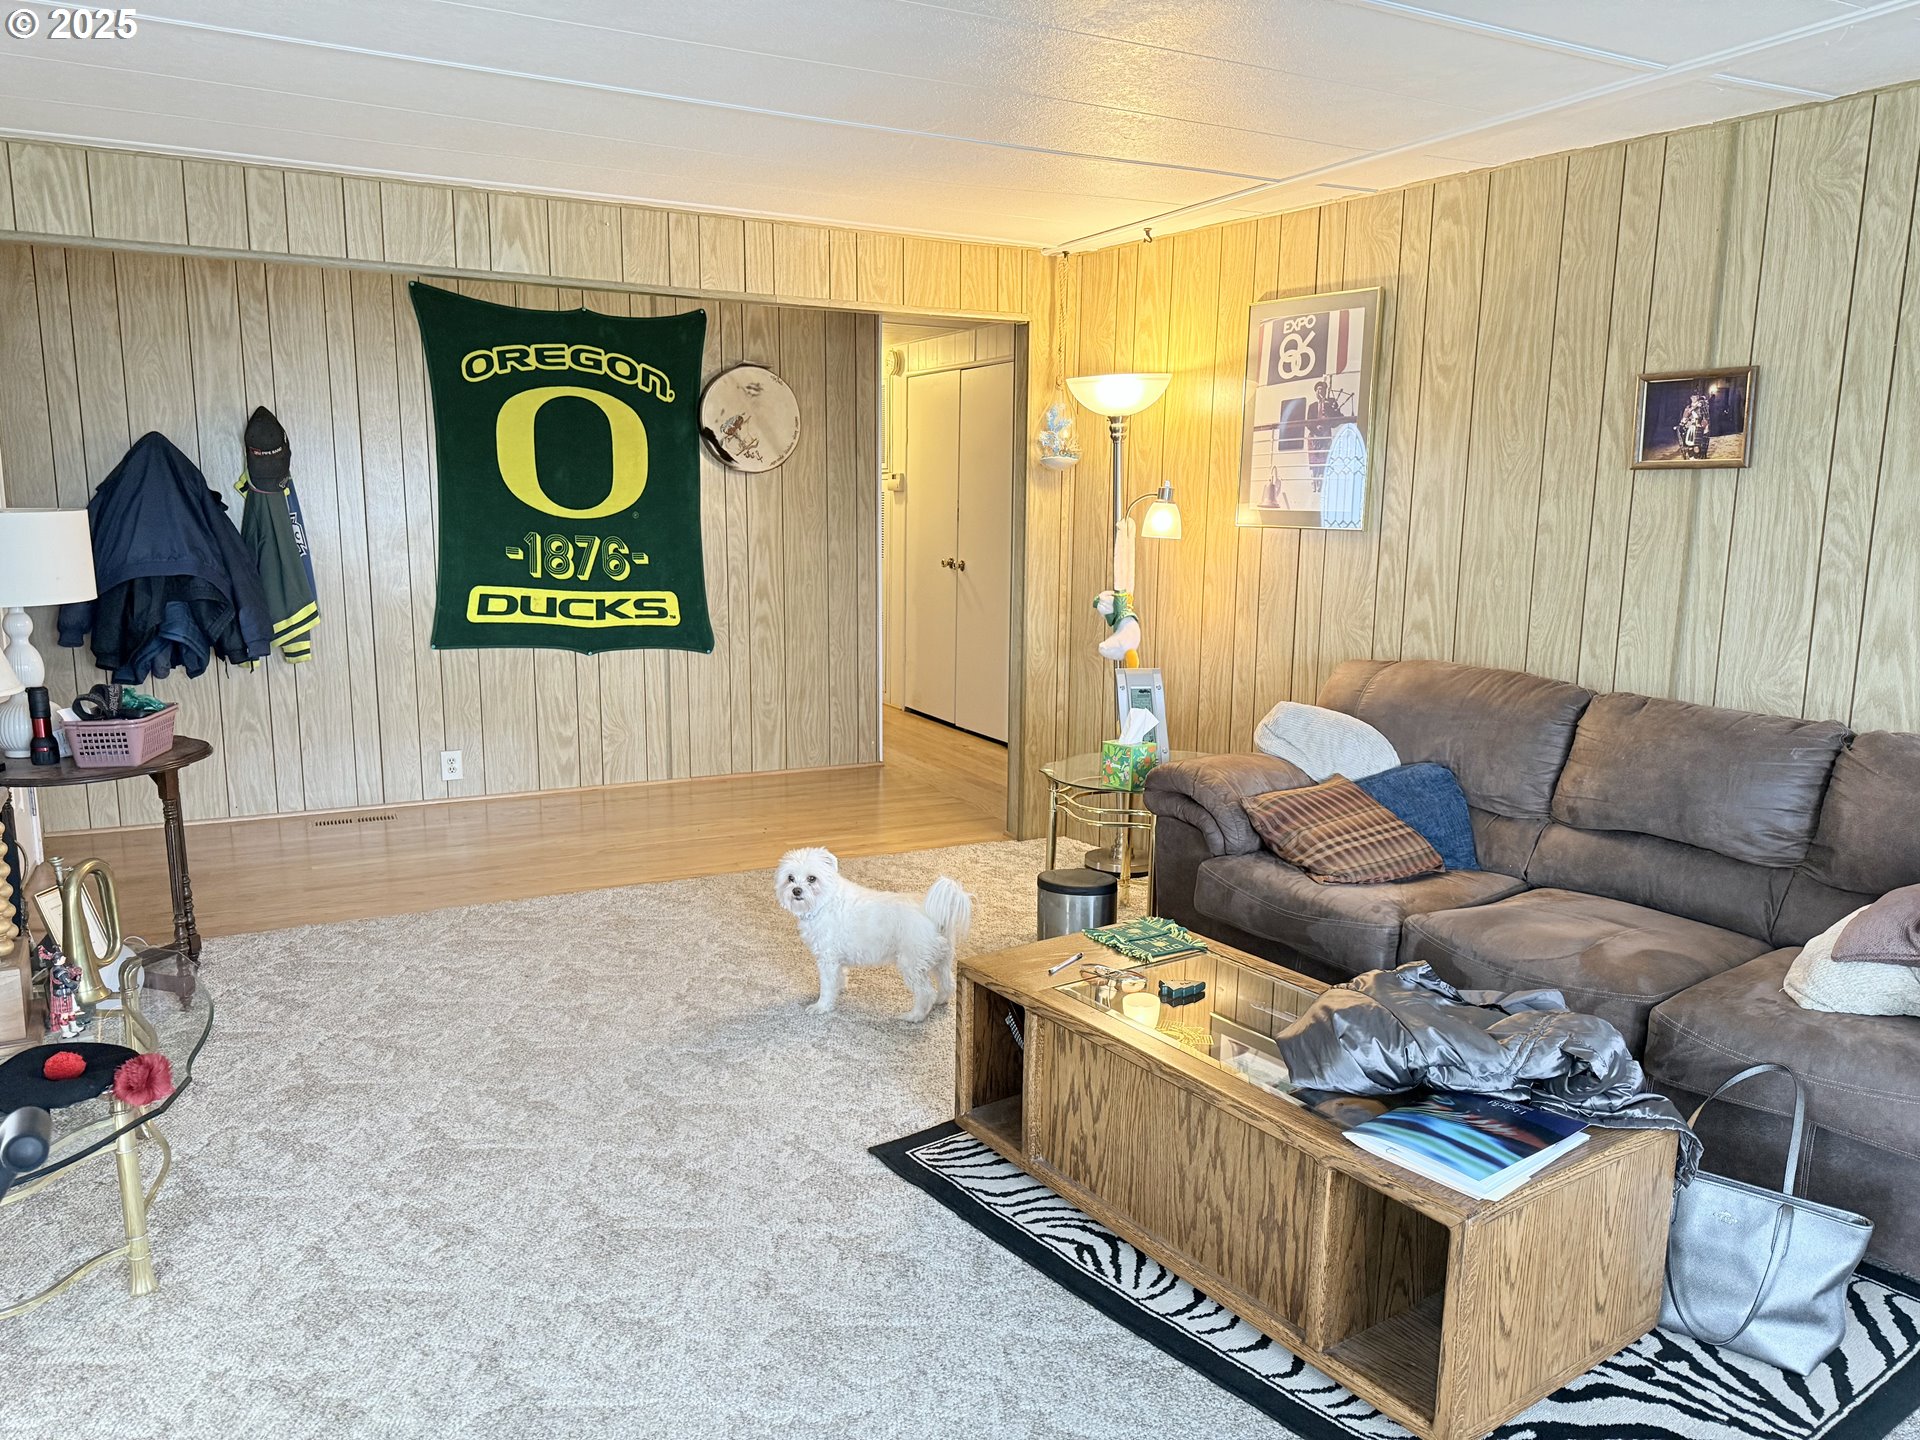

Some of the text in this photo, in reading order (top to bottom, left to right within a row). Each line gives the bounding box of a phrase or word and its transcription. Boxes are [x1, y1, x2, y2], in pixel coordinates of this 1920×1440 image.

[1283, 314, 1317, 334] EXPO
[1278, 330, 1316, 380] 86
[496, 386, 649, 519] O
[476, 593, 669, 621] DUCKS
[1151, 943, 1183, 953] RUG
